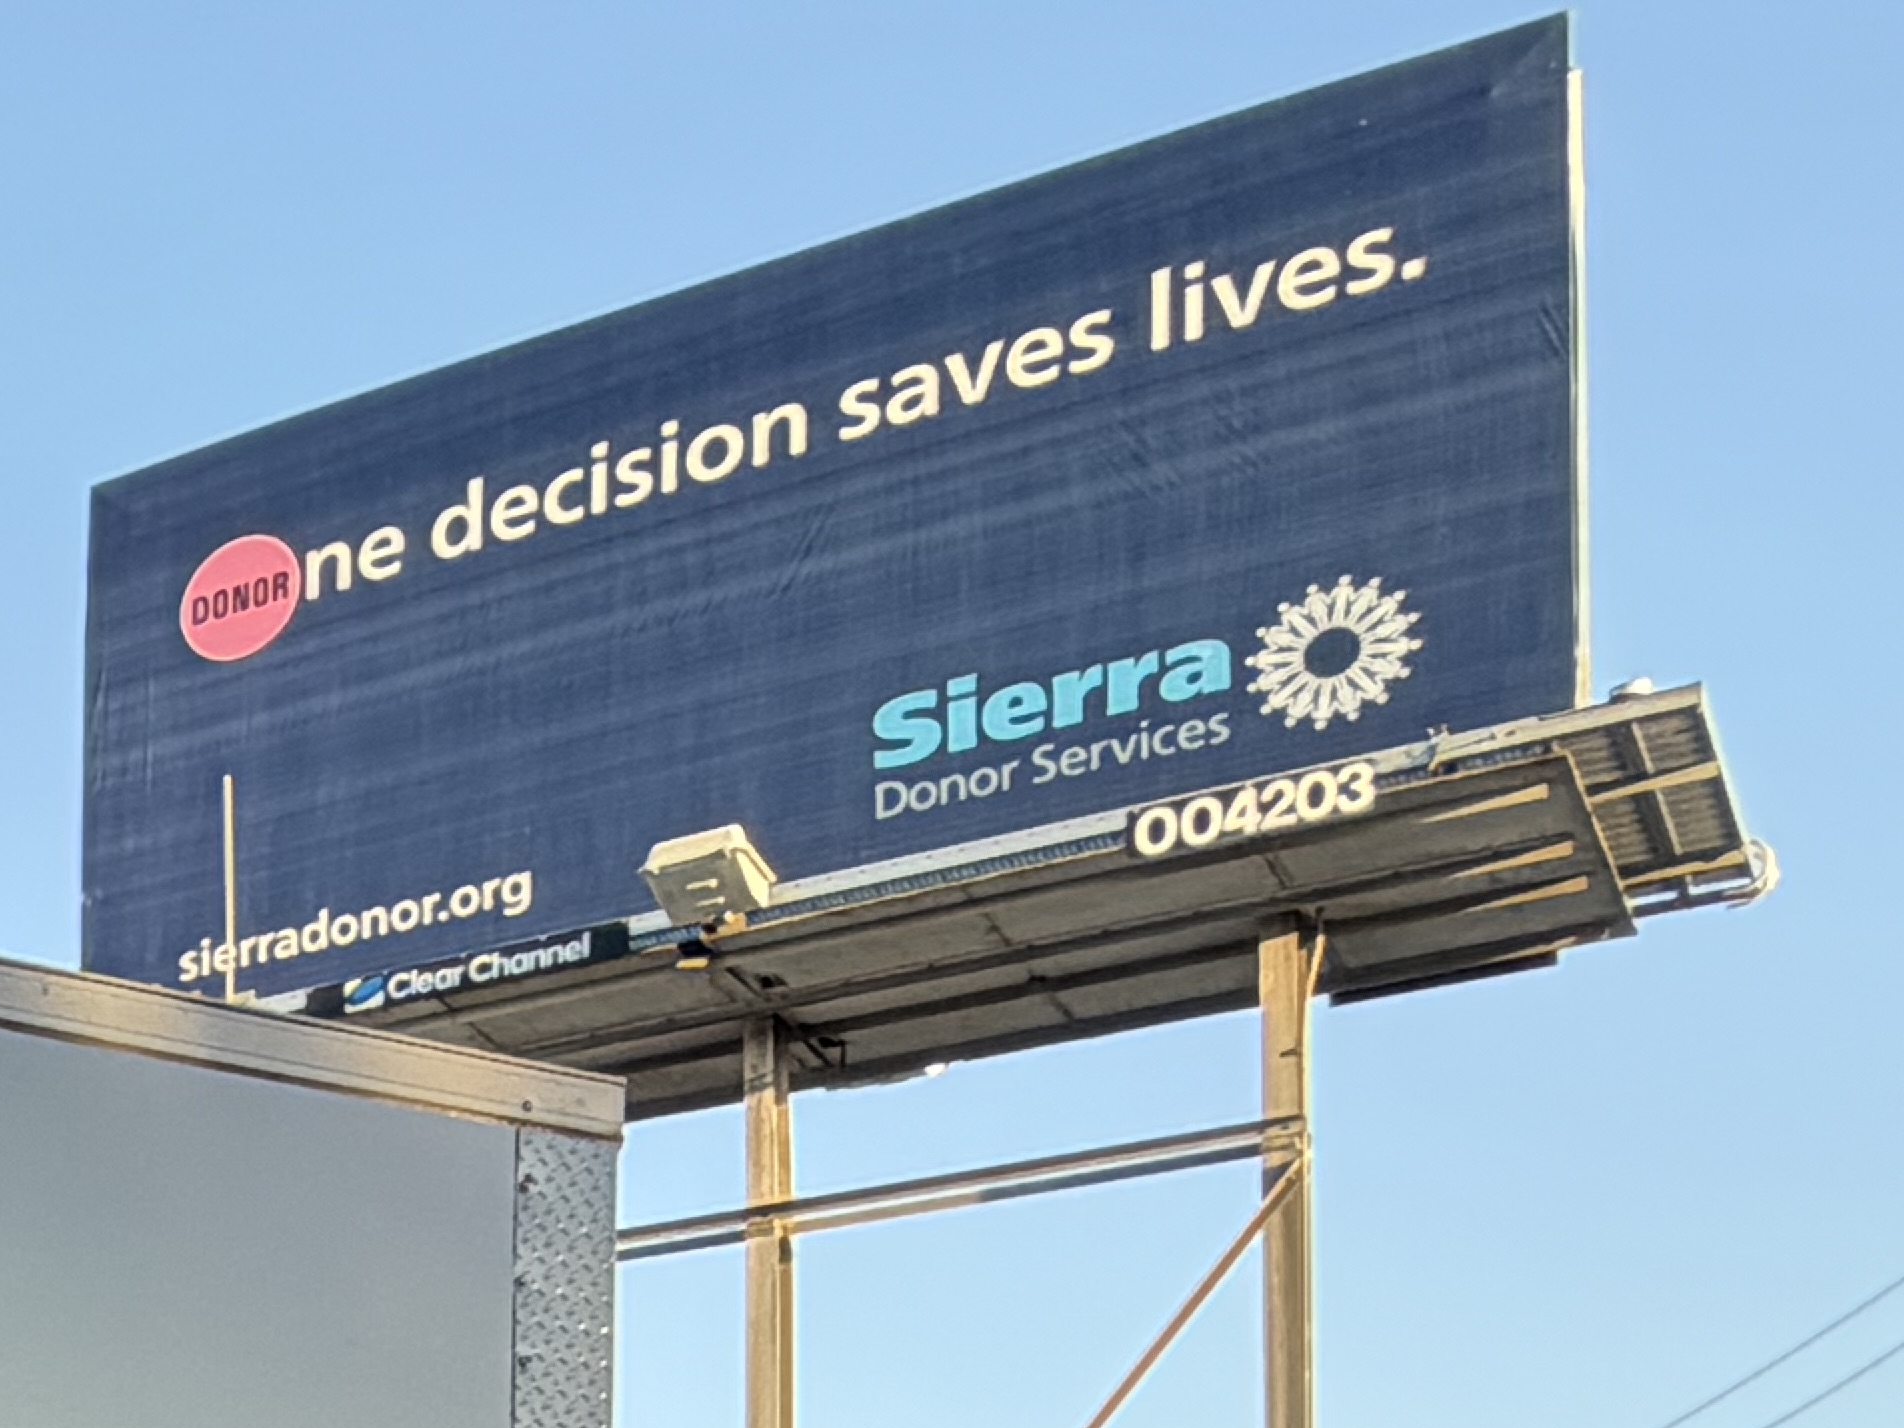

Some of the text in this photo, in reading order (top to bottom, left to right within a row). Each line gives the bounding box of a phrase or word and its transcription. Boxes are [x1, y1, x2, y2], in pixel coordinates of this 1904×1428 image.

[431, 402, 809, 560] decision
[838, 308, 1113, 442] saves
[1148, 225, 1428, 352] lives.
[191, 570, 291, 626] DONOR
[872, 638, 1233, 770] Sierra
[874, 711, 1232, 820] Donor Services
[1133, 761, 1377, 858] 004203
[178, 870, 534, 983] sierradonor.org
[387, 931, 592, 1000] Clear Channel
